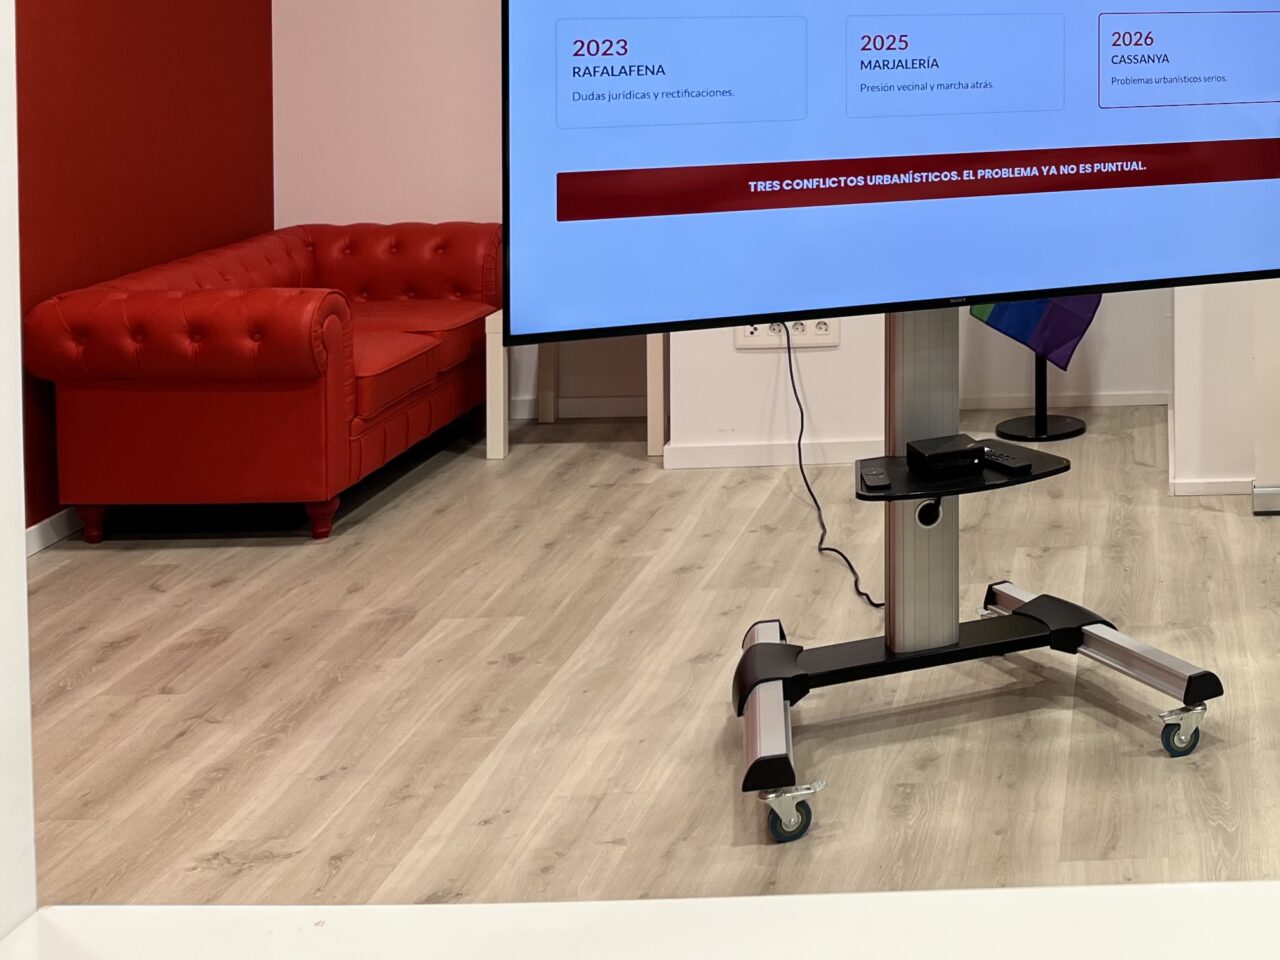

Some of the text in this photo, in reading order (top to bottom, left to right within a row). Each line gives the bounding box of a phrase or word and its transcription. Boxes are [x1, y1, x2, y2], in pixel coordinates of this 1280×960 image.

[860, 34, 909, 51] 2025
[1111, 31, 1154, 47] 2026
[572, 38, 629, 57] 2023
[860, 56, 940, 71] MARJALERÍA
[1111, 53, 1170, 65] CASSANYA
[572, 64, 666, 78] RAFALAFENA
[860, 82, 894, 92] Presión
[897, 81, 928, 92] vecinal
[929, 83, 936, 91] y
[937, 80, 969, 90] marcha
[1111, 76, 1153, 85] Problemas
[1154, 75, 1202, 84] urbanísticos
[572, 88, 735, 102] Dudas jurídicas y rectificaciones.
[748, 161, 1147, 192] TRES CONFLICTOS URBANÍSTICOS. EL PROBLEMA YA NO ES PUNTUAL.
